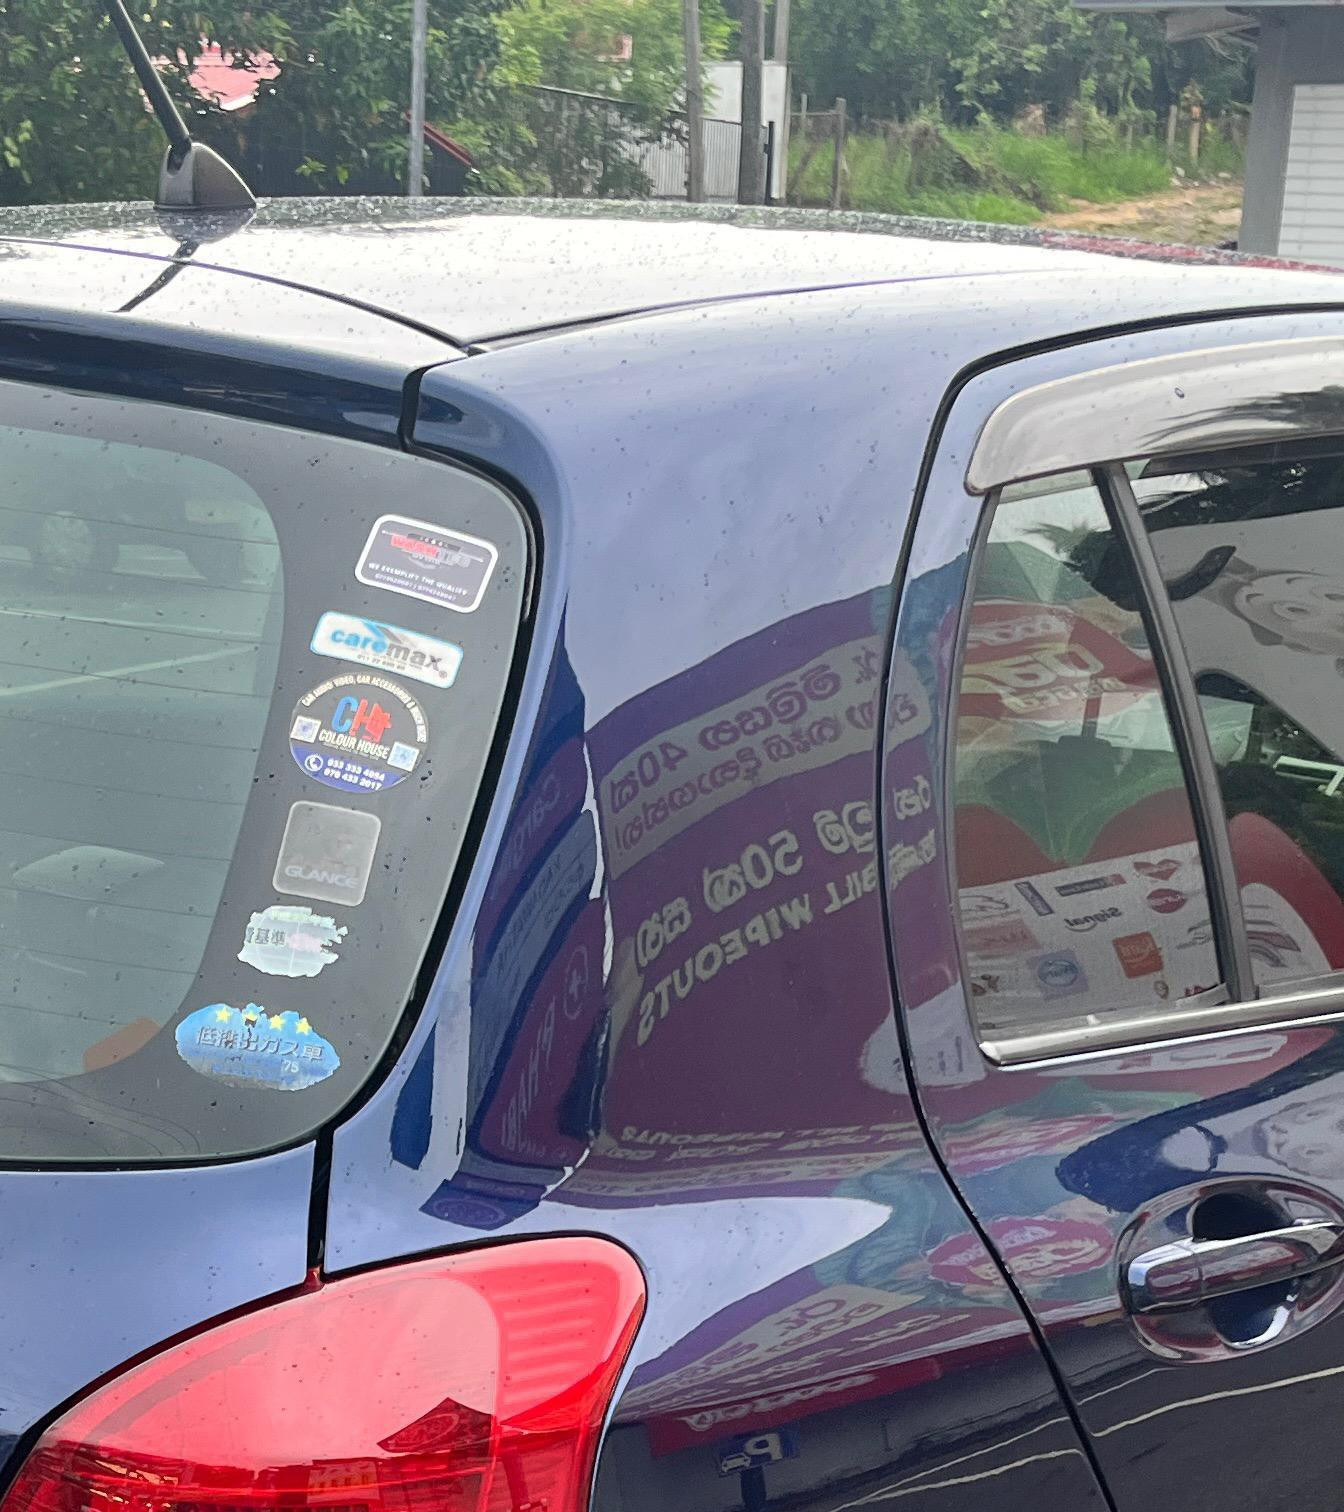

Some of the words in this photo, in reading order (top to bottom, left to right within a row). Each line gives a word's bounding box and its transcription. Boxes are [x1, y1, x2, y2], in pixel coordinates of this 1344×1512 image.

[318, 729, 356, 751] COLOUR
[355, 738, 390, 760] HOUSE
[283, 863, 358, 888] GLANCE
